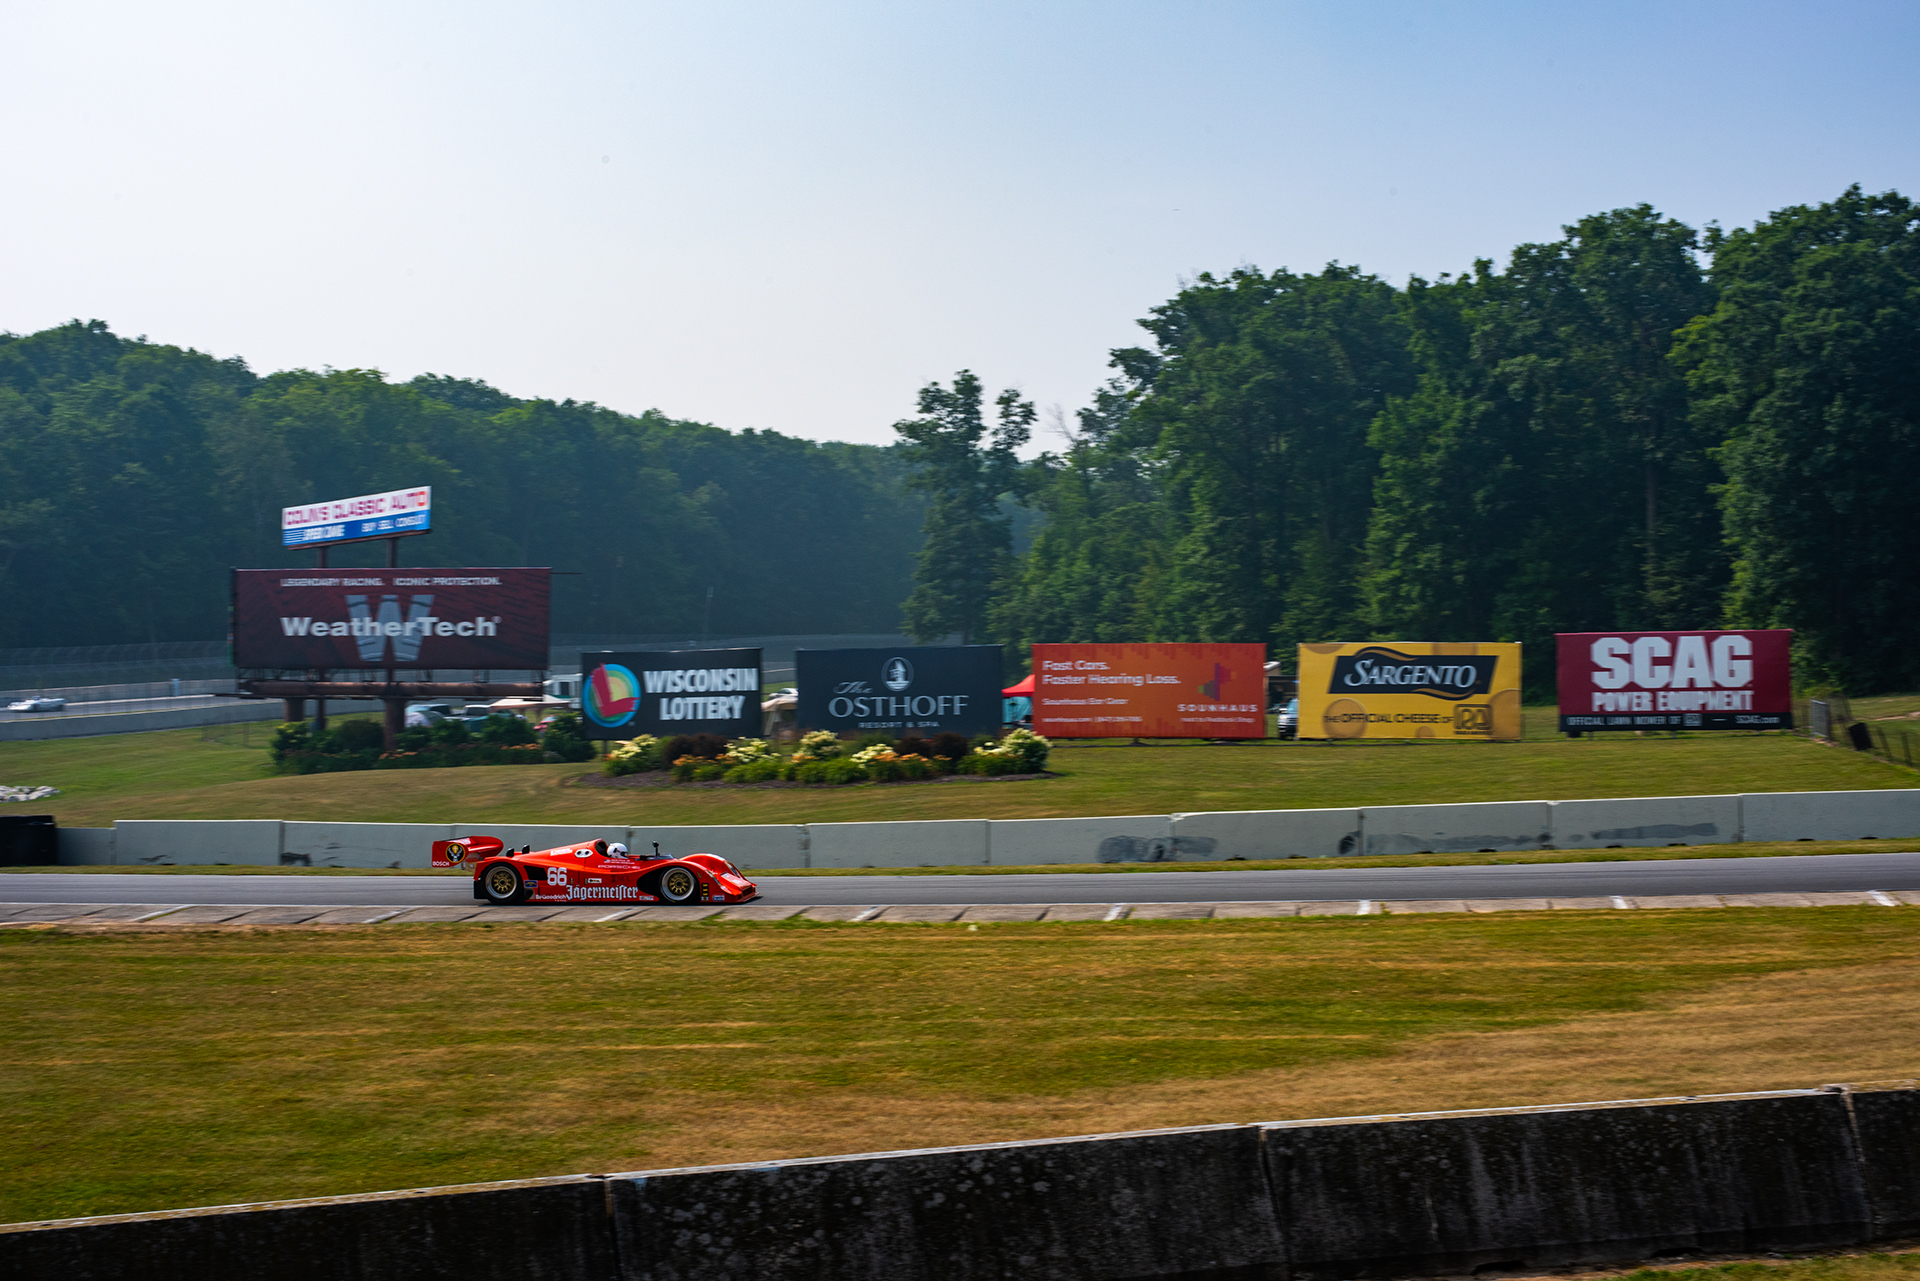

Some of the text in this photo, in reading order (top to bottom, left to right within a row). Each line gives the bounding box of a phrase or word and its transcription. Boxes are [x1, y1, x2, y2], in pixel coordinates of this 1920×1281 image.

[333, 498, 386, 519] CLASSIC
[389, 490, 427, 510] AUTO
[280, 577, 503, 587] LEGENDARY RACING. ICONIC PROTECTION.
[279, 616, 498, 637] WeatherTech
[1042, 660, 1111, 670] Fast Cars.
[1590, 635, 1754, 689] SCAG
[642, 668, 759, 693] WISCONSIN
[1042, 673, 1182, 686] Faster Hearing Loss.
[1343, 658, 1478, 688] SARGENTO
[833, 681, 873, 694] The
[659, 695, 746, 720] LOTTERY
[828, 695, 969, 718] OSTHOFF
[1088, 697, 1104, 705] Ear
[1105, 697, 1129, 705] Gear
[1177, 703, 1259, 712] SOUNHAUS
[1591, 690, 1754, 712] POWER EQUIPMENT
[858, 721, 903, 729] RESORT
[1324, 713, 1454, 724] THE OFFICIAL CHEESE OF
[1566, 716, 1606, 726] OFFICIAL
[1606, 716, 1632, 726] LAWN
[1633, 715, 1668, 725] MOWER
[1668, 715, 1683, 725] OF
[547, 867, 567, 886] 66
